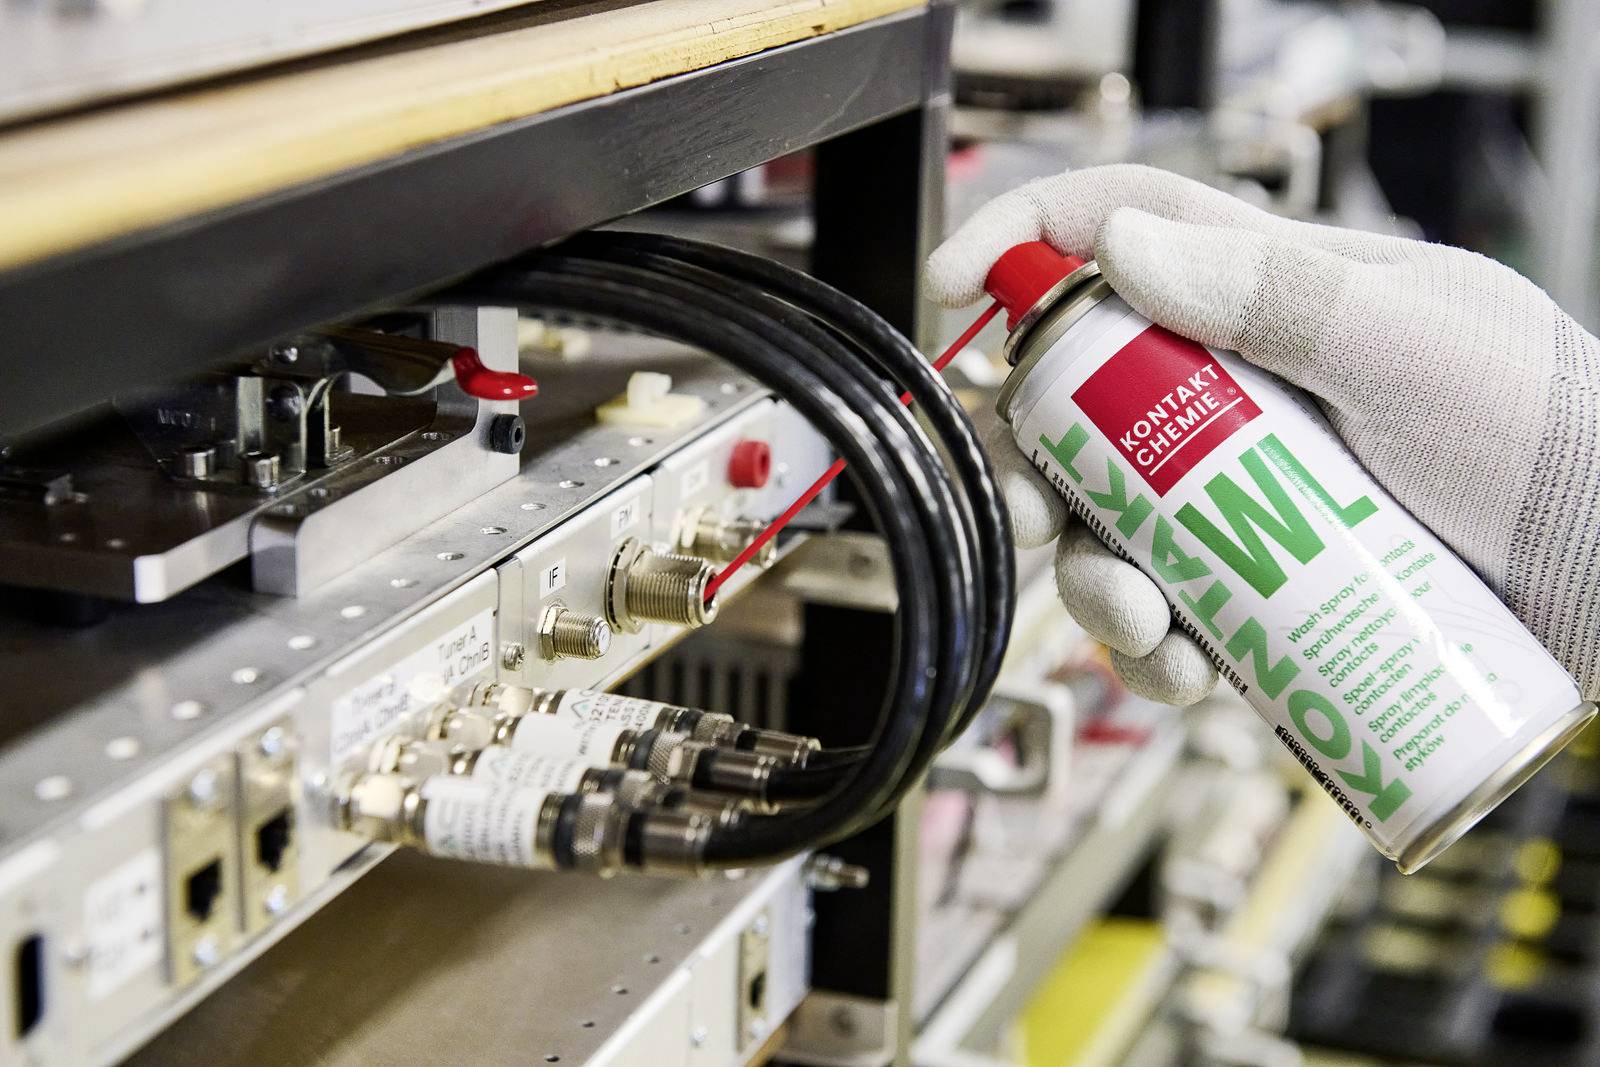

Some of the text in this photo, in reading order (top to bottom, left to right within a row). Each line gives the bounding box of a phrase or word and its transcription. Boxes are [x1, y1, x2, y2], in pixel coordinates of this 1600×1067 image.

[1120, 363, 1219, 452] KONTAKT
[1136, 391, 1220, 466] CHEMIE
[1174, 432, 1380, 599] WL
[548, 565, 559, 589] IF
[1287, 612, 1320, 645] Wash
[1319, 585, 1355, 616] Spray
[1354, 570, 1371, 589] fo
[437, 625, 477, 660] Tuner A
[1038, 422, 1412, 822] KONTAKT
[1302, 592, 1380, 661] Sprühwasche
[1317, 645, 1352, 677] Spray
[1351, 608, 1394, 645] nettoya
[1329, 642, 1381, 688] contacts
[1342, 642, 1413, 704] Spoel-spray
[1353, 662, 1411, 716] contacten
[1368, 703, 1405, 732] Spray
[1379, 690, 1438, 744] contactos
[1393, 699, 1464, 761] Preparat do
[1403, 734, 1445, 773] styków
